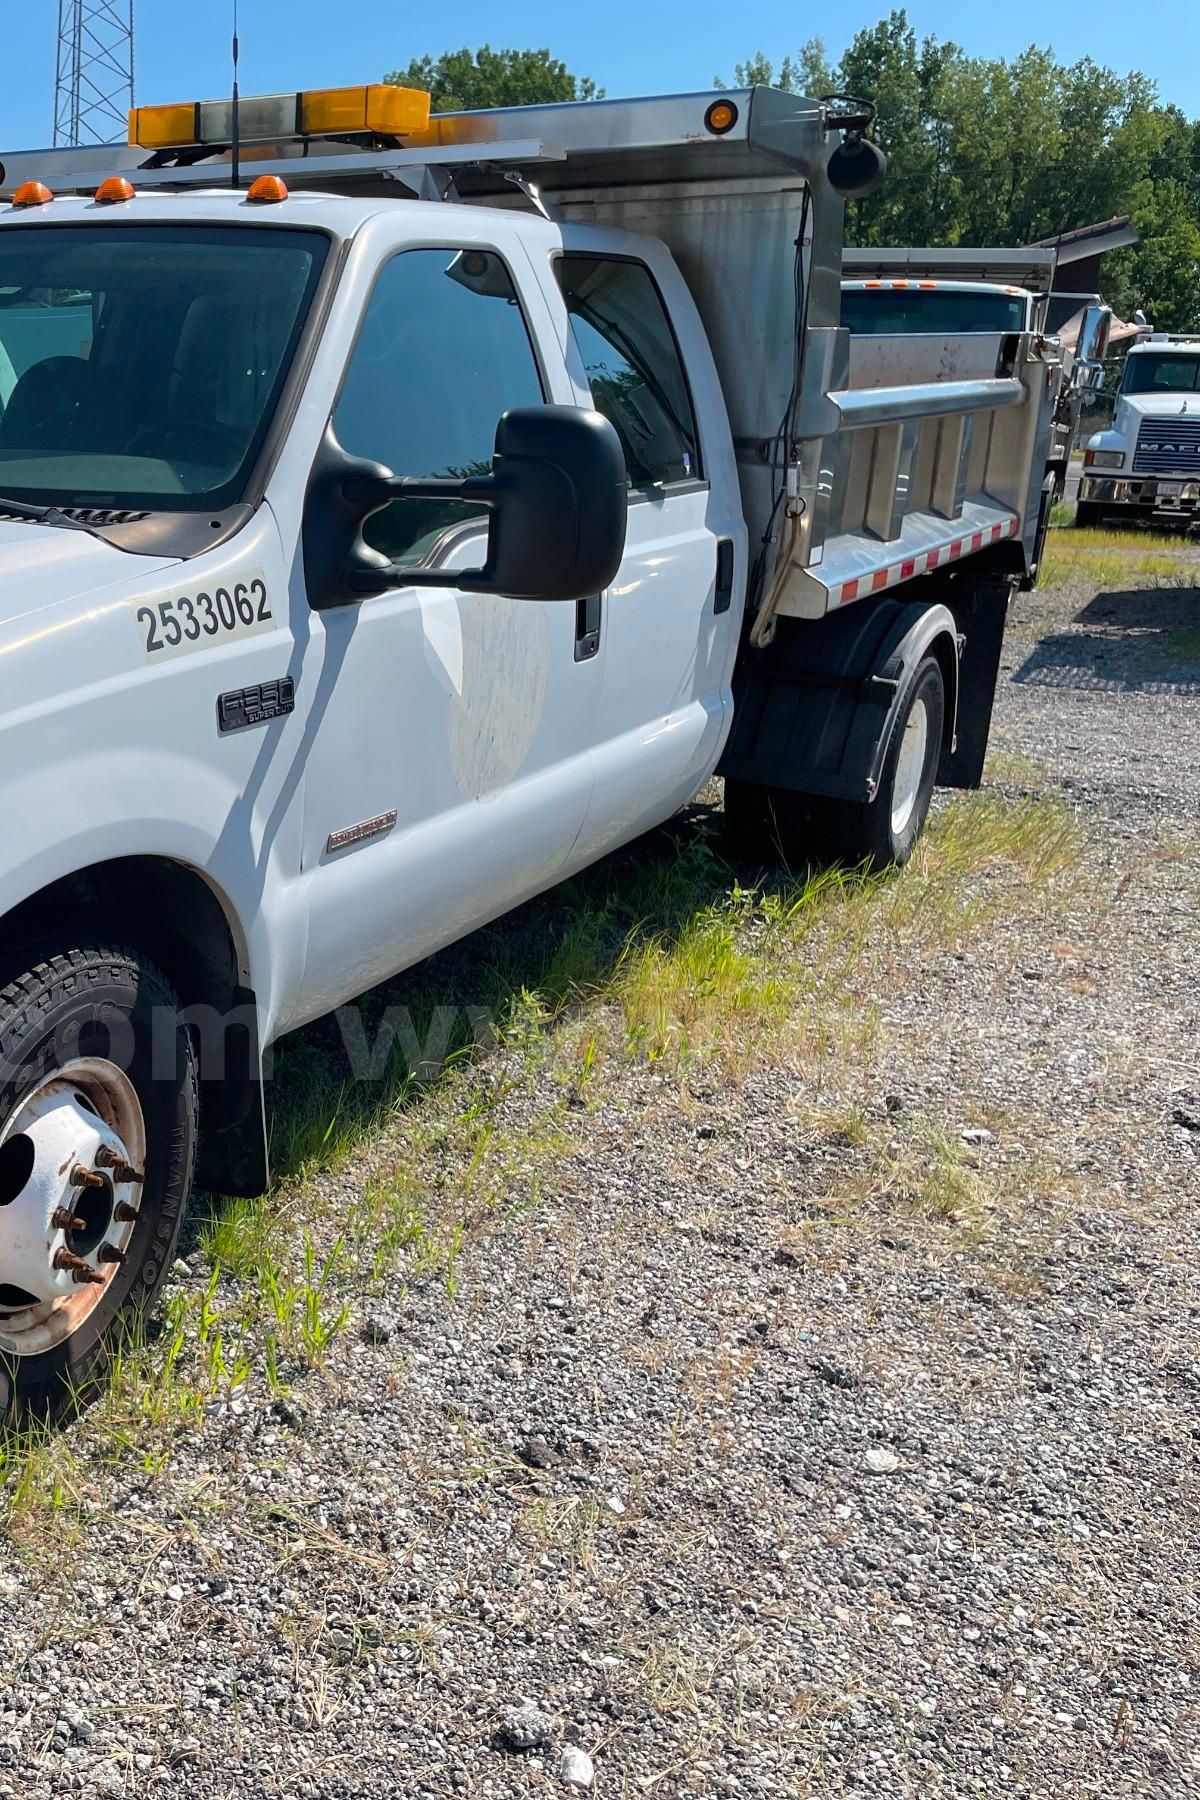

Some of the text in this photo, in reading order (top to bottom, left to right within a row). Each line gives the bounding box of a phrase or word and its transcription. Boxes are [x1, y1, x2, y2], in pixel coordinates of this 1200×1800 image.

[1140, 443, 1200, 453] MAC
[136, 578, 273, 653] 2533062
[248, 708, 275, 722] SUPER
